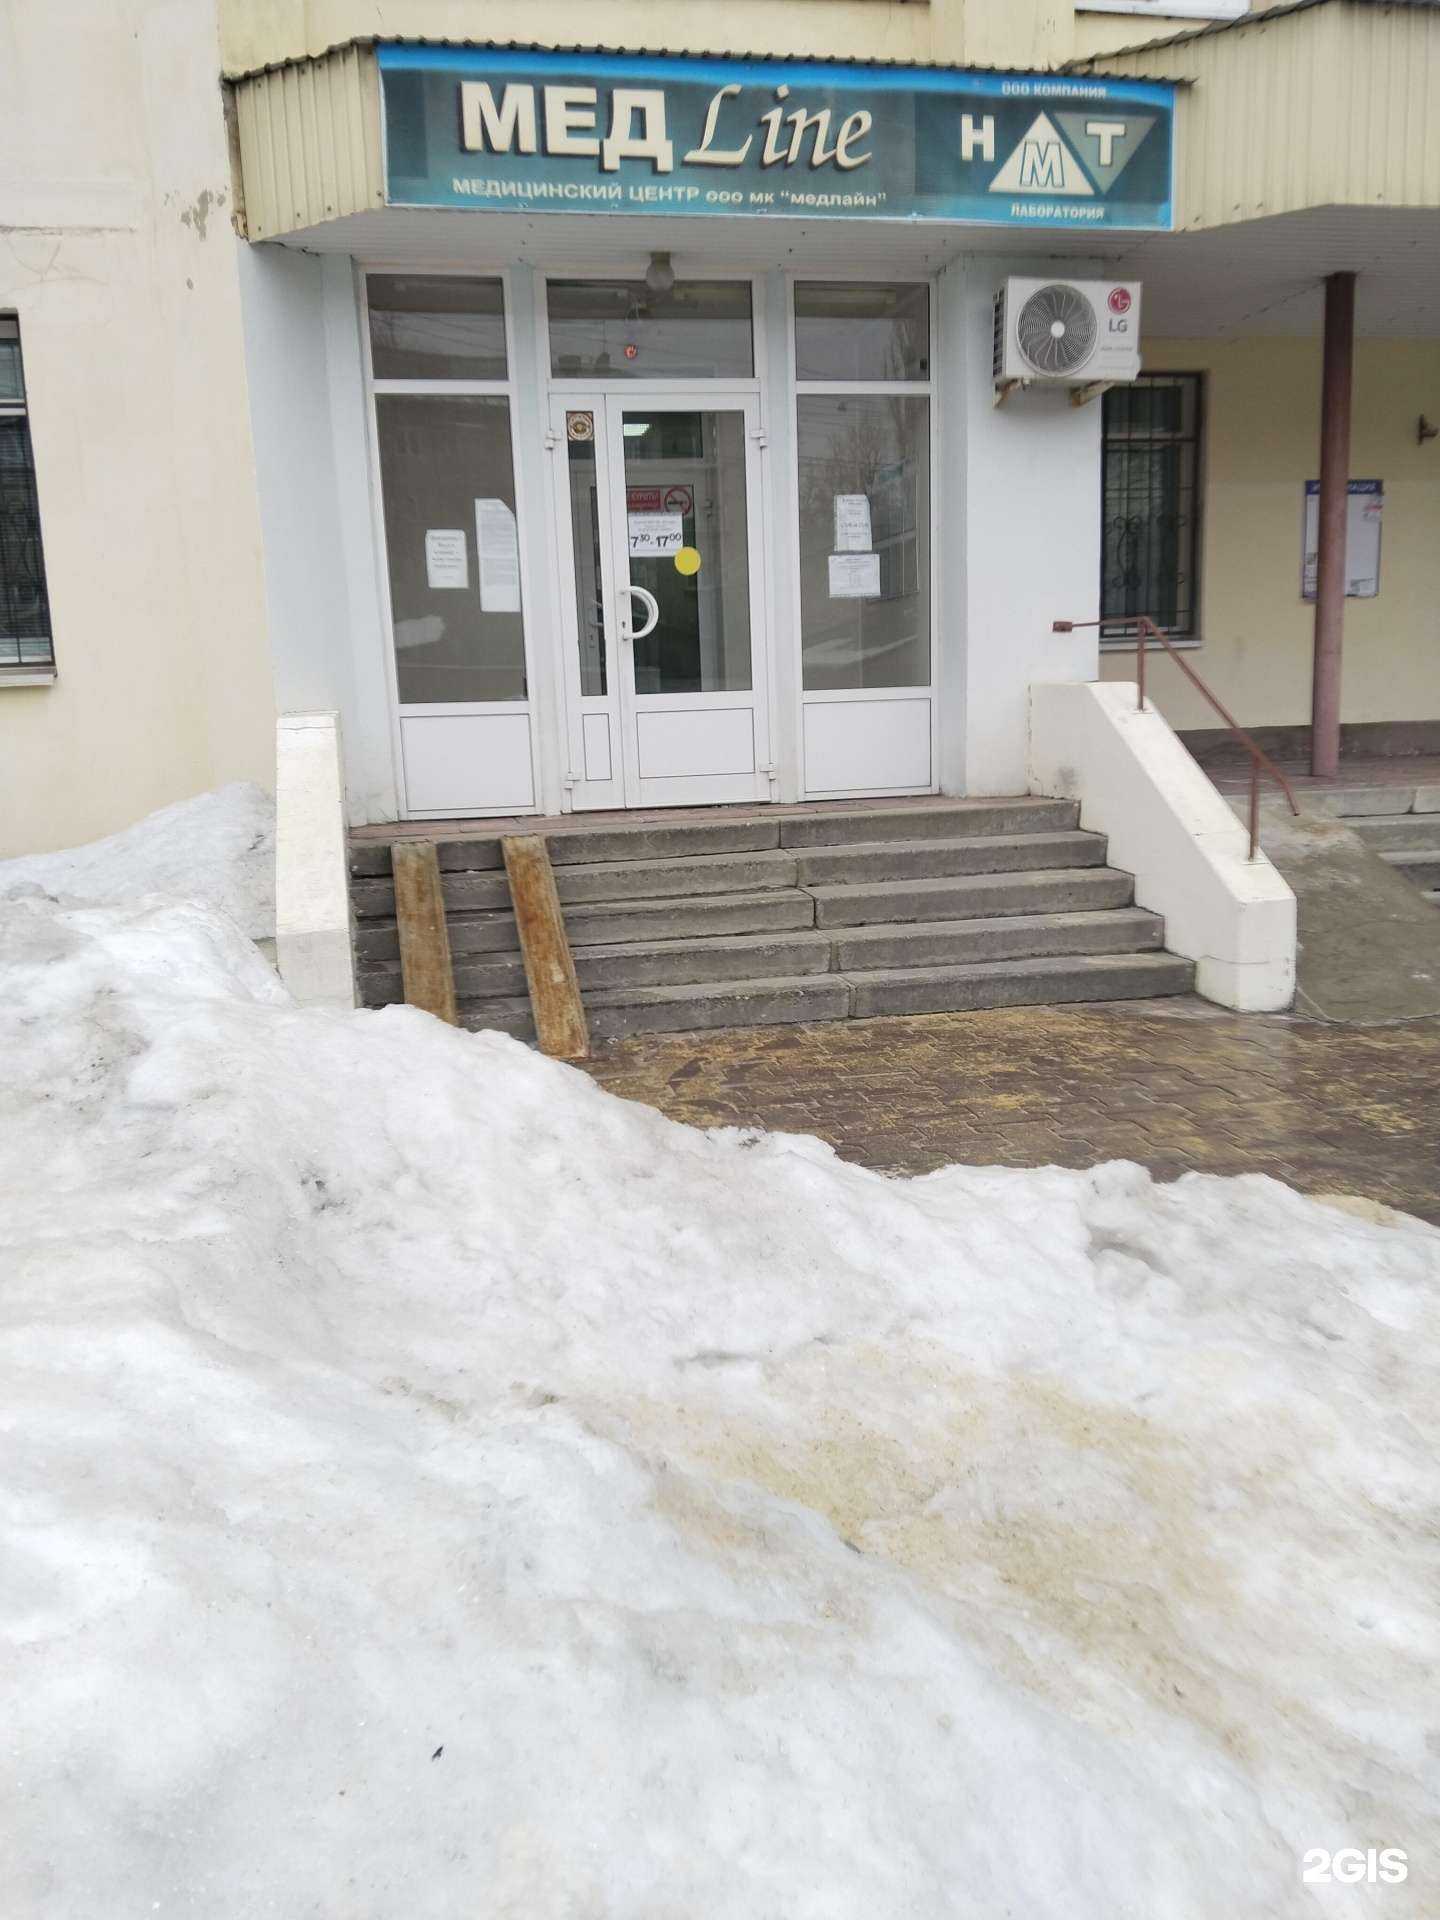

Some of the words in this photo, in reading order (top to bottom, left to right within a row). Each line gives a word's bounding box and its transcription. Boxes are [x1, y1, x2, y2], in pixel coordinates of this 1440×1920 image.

[1001, 80, 1030, 96] ООО
[1033, 80, 1107, 99] КОМПАНИЯ
[461, 80, 674, 172] МЕД
[682, 83, 872, 169] Line
[452, 177, 622, 200] МЕДИЦИНСКИЙ
[629, 184, 700, 203] ЦЕНТР
[1010, 202, 1105, 219] ЛАБОРАТОРИЯ
[1108, 318, 1128, 333] LG
